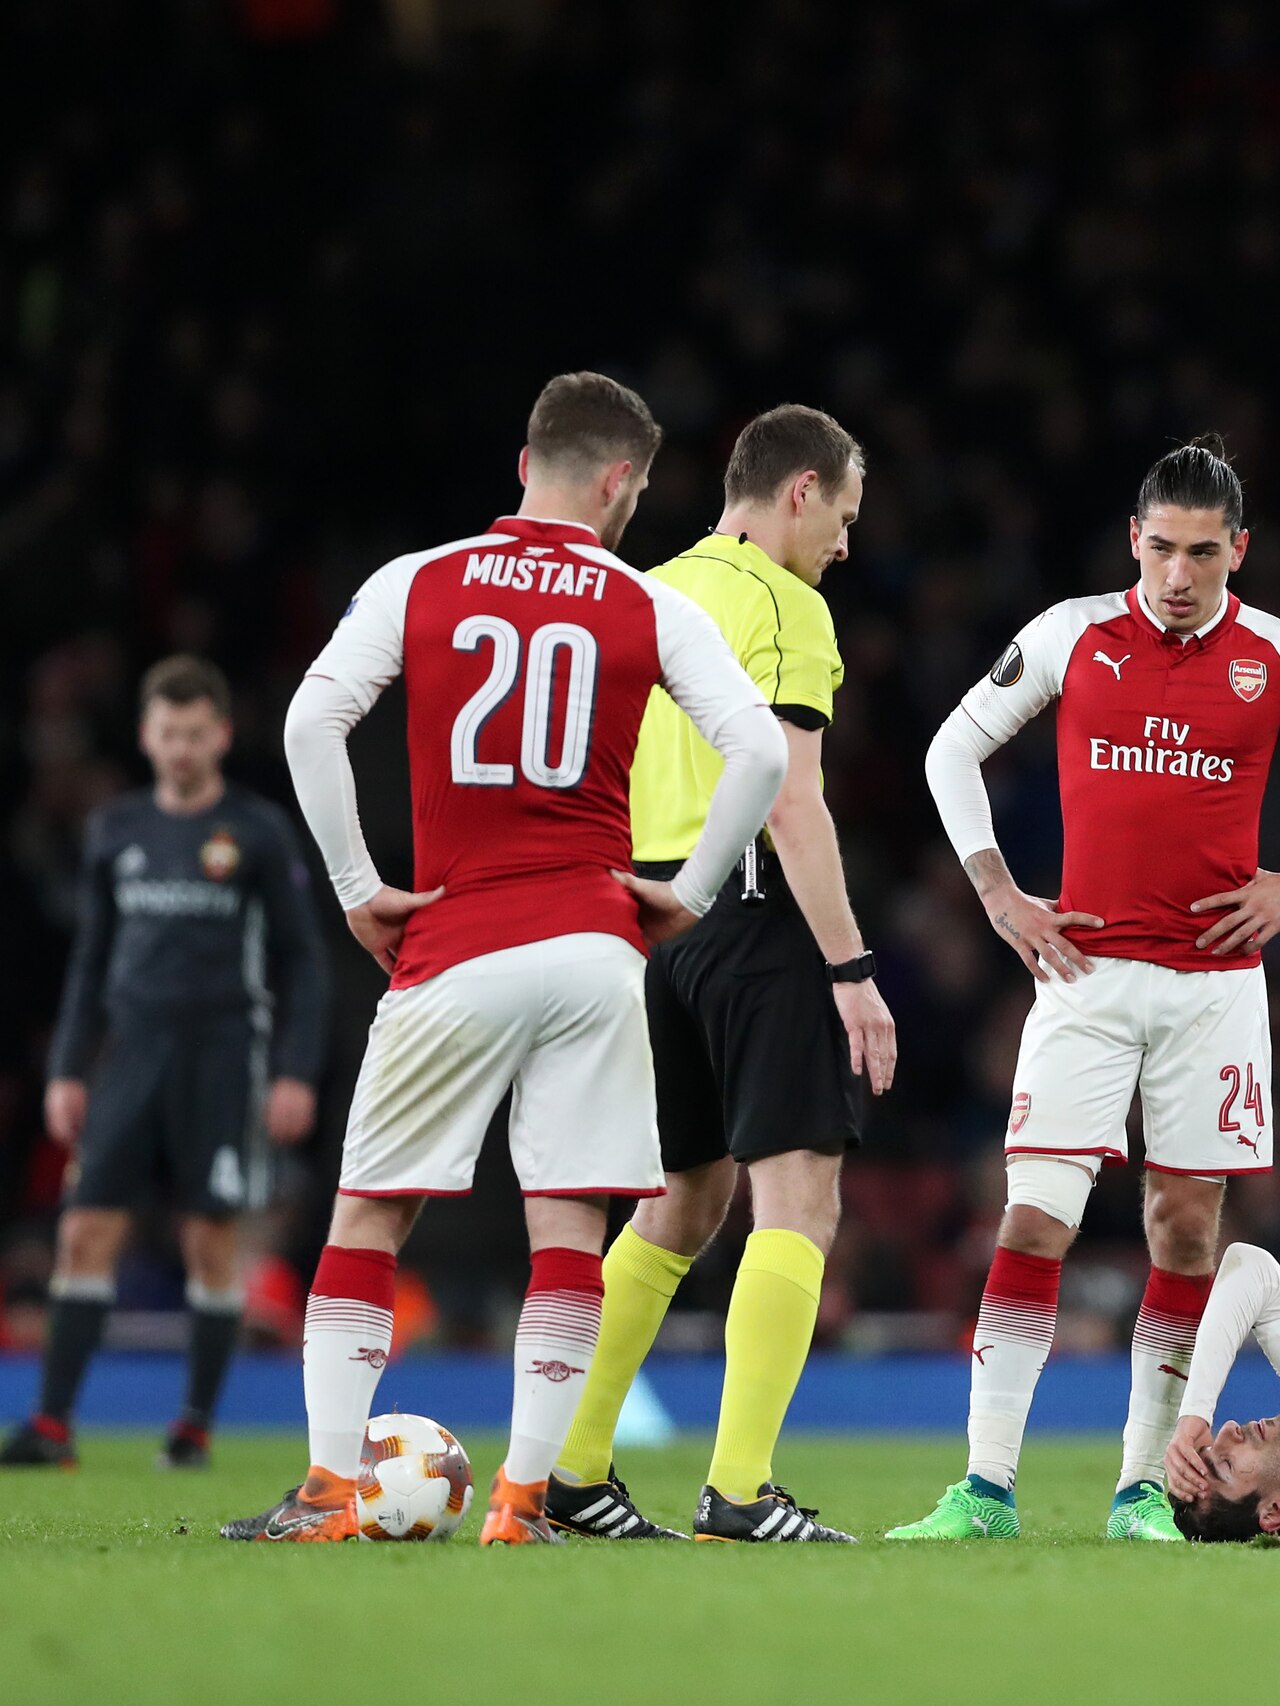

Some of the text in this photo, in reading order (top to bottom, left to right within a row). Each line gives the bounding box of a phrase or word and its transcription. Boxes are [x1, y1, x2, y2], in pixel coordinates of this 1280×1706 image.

[462, 553, 607, 600] MUSTAFI
[1234, 665, 1263, 676] Arsenal
[450, 614, 599, 790] 20
[1143, 715, 1190, 745] Fly
[1089, 738, 1235, 782] Emirates
[1218, 1062, 1265, 1132] 24
